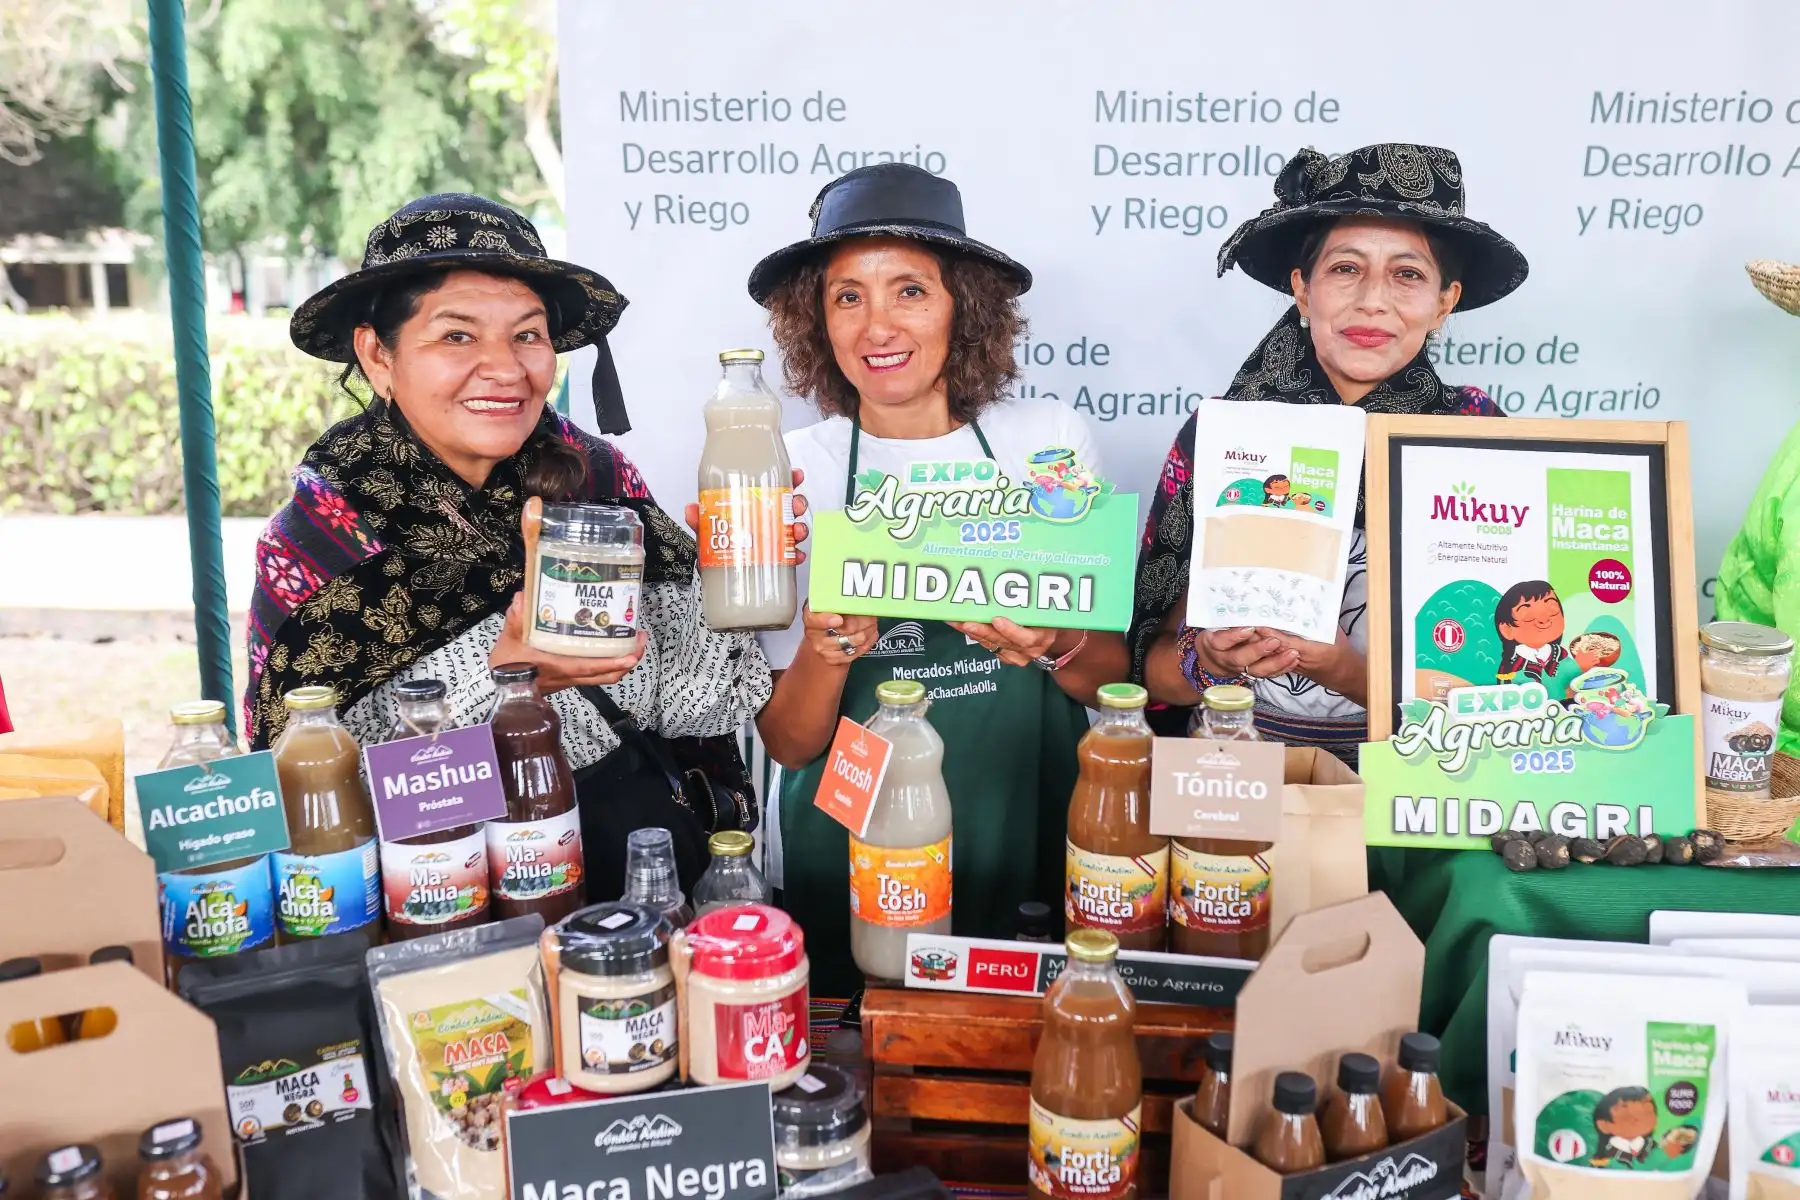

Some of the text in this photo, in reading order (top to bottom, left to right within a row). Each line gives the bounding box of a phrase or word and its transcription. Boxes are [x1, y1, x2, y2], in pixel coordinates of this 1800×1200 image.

[619, 90, 847, 122] Ministerio de
[1095, 90, 1340, 123] Ministerio de
[1590, 90, 1773, 124] Ministerio
[622, 143, 799, 174] Desarrollo
[1094, 144, 1286, 176] Desarrollo
[1583, 144, 1771, 178] Desarrollo
[624, 194, 750, 232] y Riego
[1090, 197, 1228, 236] y Riego
[1577, 198, 1704, 236] y Riego
[1066, 336, 1110, 366] de
[1536, 335, 1579, 365] de
[1534, 382, 1661, 419] Agrario
[1224, 450, 1268, 464] Mikuy
[909, 459, 996, 484] EXPO
[1292, 462, 1335, 477] Maca
[1292, 474, 1335, 489] Negra
[843, 473, 1034, 541] Agraria
[1430, 494, 1530, 528] Mikuy
[1552, 503, 1628, 519] Harina de
[960, 520, 1022, 543] 2025
[1476, 525, 1512, 535] FOODS
[1552, 516, 1629, 540] Maca
[1437, 541, 1508, 552] Altamente Nutritivo
[1437, 553, 1508, 564] Energizante Natural
[840, 559, 1094, 612] MIDAGRI
[1590, 580, 1630, 591] Natural
[1595, 570, 1625, 580] 100%
[575, 583, 614, 600] MACA
[579, 598, 608, 608] NEGRA
[892, 658, 1001, 681] Mercados Midagri
[1456, 686, 1544, 713] EXPO
[1710, 703, 1751, 720] Mikuy
[1392, 704, 1583, 772] Agraria
[832, 749, 873, 793] Tocosh
[1511, 750, 1576, 772] 2025
[1713, 753, 1766, 772] MACA
[382, 760, 493, 800] Mashua
[1171, 771, 1268, 800] Tónico
[1711, 768, 1754, 781] NEGRA
[148, 786, 277, 831] Alcachofa
[1393, 794, 1654, 840] MIDAGRI
[506, 844, 545, 863] Ma-
[409, 867, 450, 887] Ma-
[506, 861, 553, 880] shua
[411, 885, 458, 904] shua
[877, 873, 912, 895] To-
[1080, 876, 1129, 902] Forti-
[1194, 880, 1248, 902] Forti-
[280, 897, 334, 918] chofa
[877, 888, 927, 911] cosh
[1079, 895, 1134, 918] maca
[1194, 897, 1252, 917] maca
[187, 914, 249, 938] chofa
[975, 962, 1029, 979] PERÚ
[1162, 978, 1224, 993] Agrario
[625, 1011, 664, 1034] MACA
[631, 1028, 659, 1041] NEGRA
[1554, 1029, 1613, 1051] Mikuy
[444, 1031, 512, 1067] MACA
[744, 1032, 786, 1064] CA
[275, 1071, 320, 1096] MACA
[283, 1088, 316, 1103] NEGRA
[645, 1157, 768, 1200] Negra
[1060, 1164, 1121, 1185] maca
